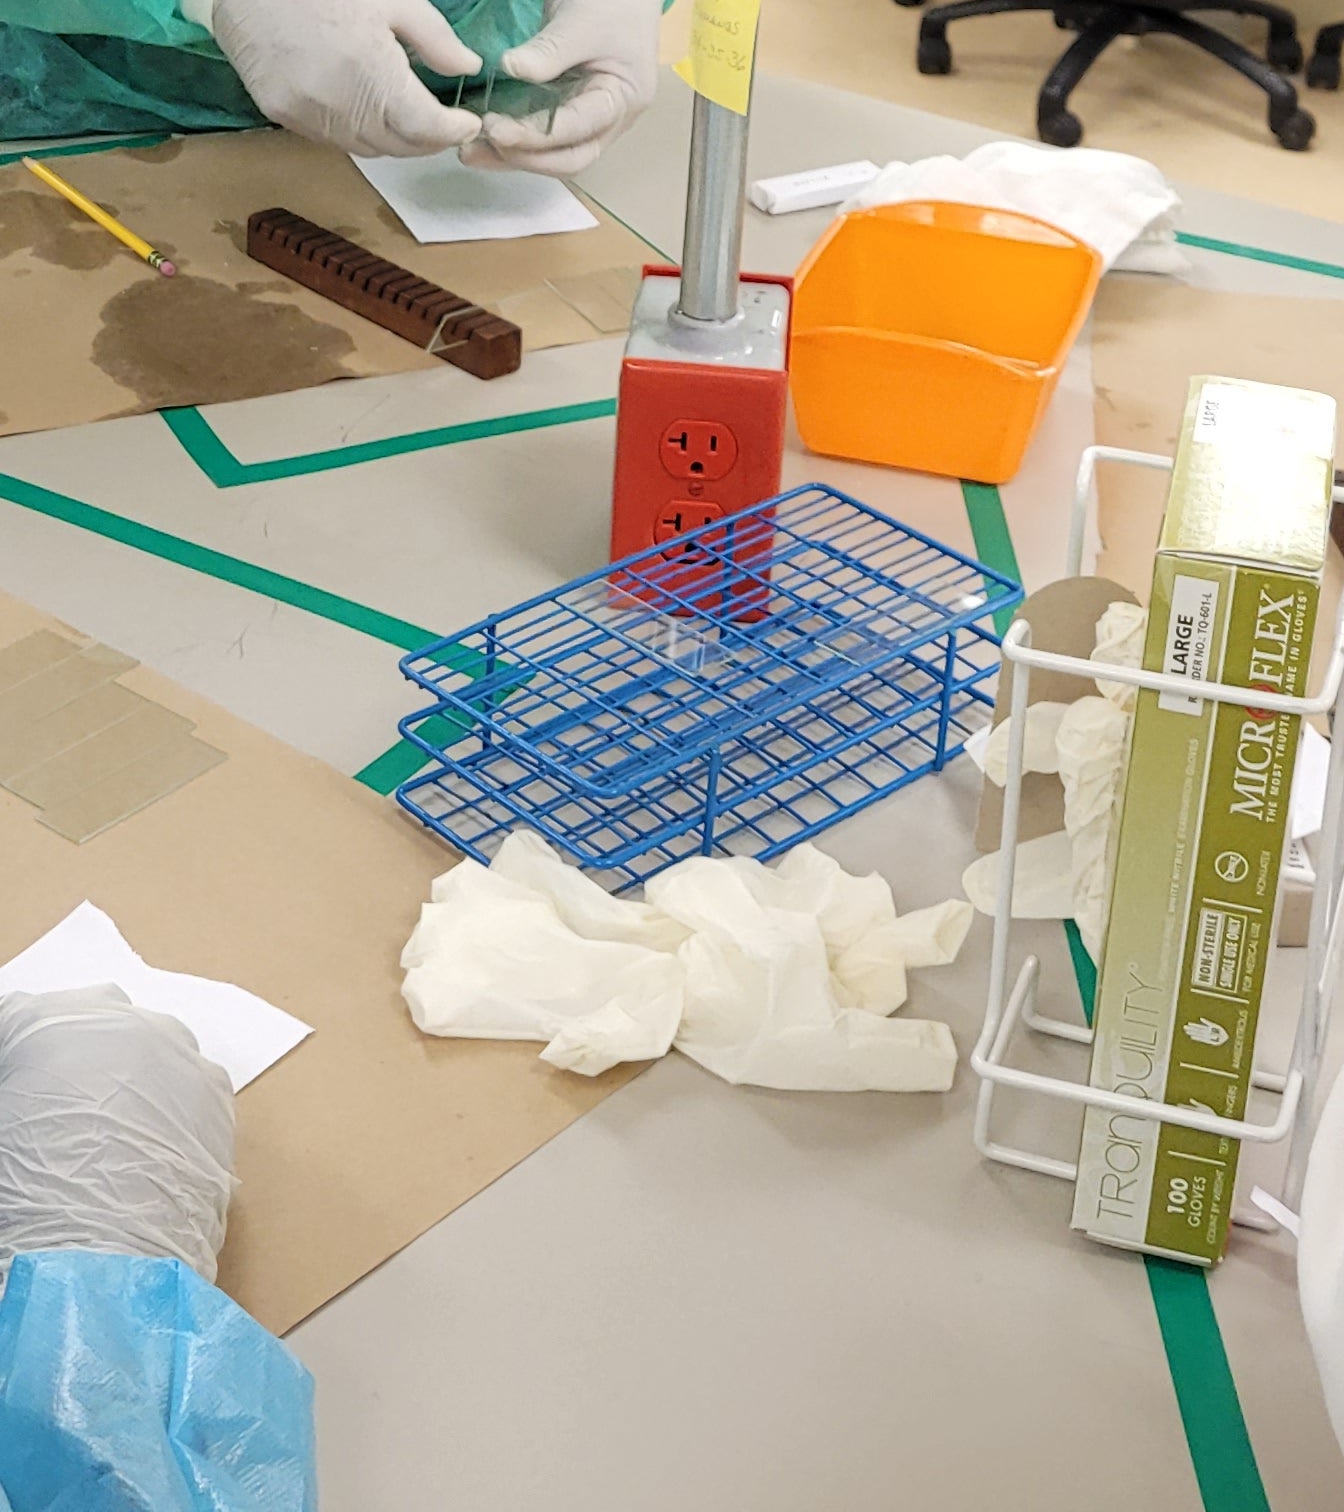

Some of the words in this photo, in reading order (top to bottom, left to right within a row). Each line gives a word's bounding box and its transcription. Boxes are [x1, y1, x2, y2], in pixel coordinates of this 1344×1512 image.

[1197, 592, 1212, 634] TQ-601-L
[1291, 595, 1308, 642] GLOVES
[1170, 614, 1194, 675] LARGE
[1289, 646, 1301, 661] IN
[1275, 711, 1291, 758] TRUSTE
[1270, 763, 1284, 796] MOST
[1266, 801, 1279, 823] THE
[1226, 917, 1241, 940] ONLY
[1198, 914, 1219, 983] NON-STERILE
[1223, 941, 1238, 958] USE
[1219, 959, 1236, 988] SINGLE
[1166, 1176, 1190, 1215] 100
[1187, 1176, 1207, 1227] GLOVES
